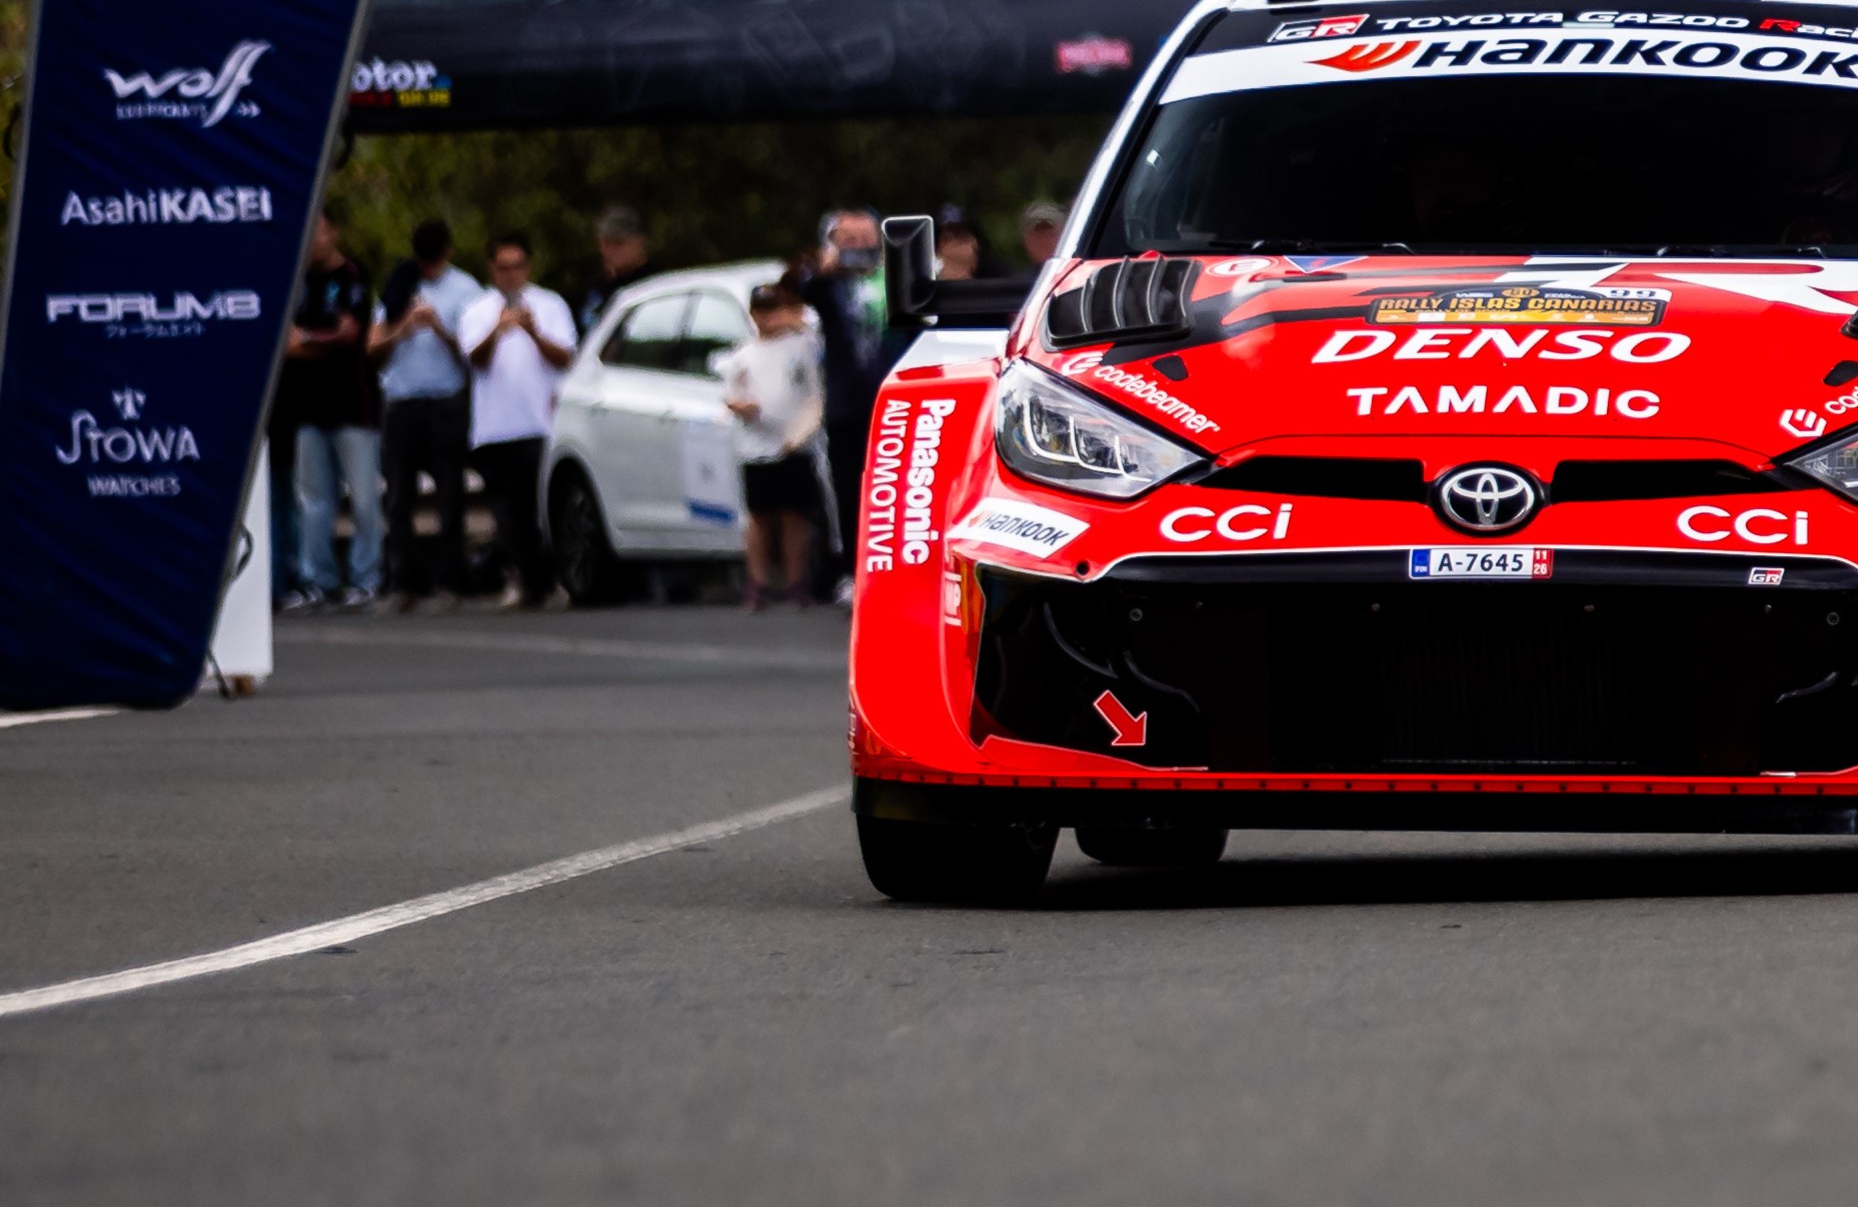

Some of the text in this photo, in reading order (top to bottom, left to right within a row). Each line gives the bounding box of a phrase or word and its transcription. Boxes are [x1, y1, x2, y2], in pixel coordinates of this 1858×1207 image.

[1272, 18, 1361, 40] GR
[1376, 12, 1564, 31] TOYOTA
[1577, 10, 1750, 29] GAZOO
[1379, 297, 1657, 312] RALLY ISLAS CANARIAS
[1610, 289, 1656, 298] 99
[1311, 329, 1692, 364] DENSO
[1094, 364, 1219, 433] codebeamer
[1346, 385, 1661, 419] TAMADIC
[56, 409, 200, 464] STOWA
[88, 475, 181, 496] WATCHES
[867, 399, 912, 573] AUTOMOTIVE
[902, 398, 957, 565] Panasonic
[1438, 553, 1524, 572] A-7645
[1535, 550, 1548, 560] 11
[1533, 563, 1548, 575] 26
[1750, 569, 1783, 584] GR
